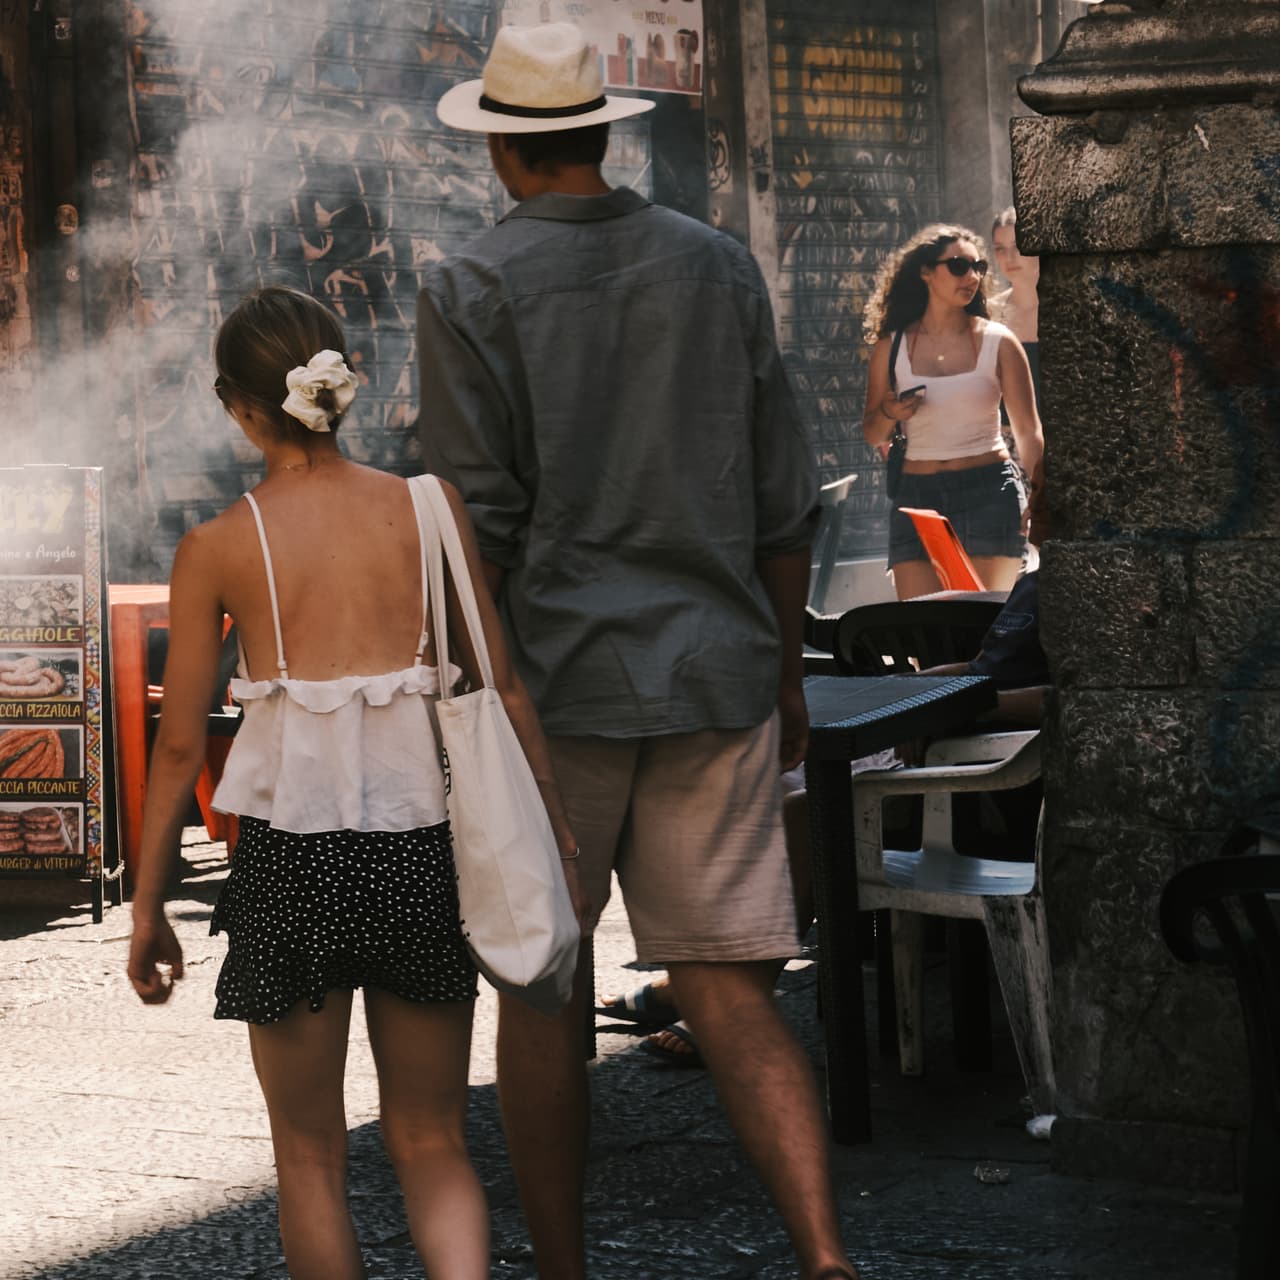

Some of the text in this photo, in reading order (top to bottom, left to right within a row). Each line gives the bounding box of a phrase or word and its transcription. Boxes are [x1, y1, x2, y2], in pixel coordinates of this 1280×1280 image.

[35, 544, 78, 563] Angelo
[26, 704, 82, 719] PIZZAIOLA
[27, 781, 81, 795] PICCANTE
